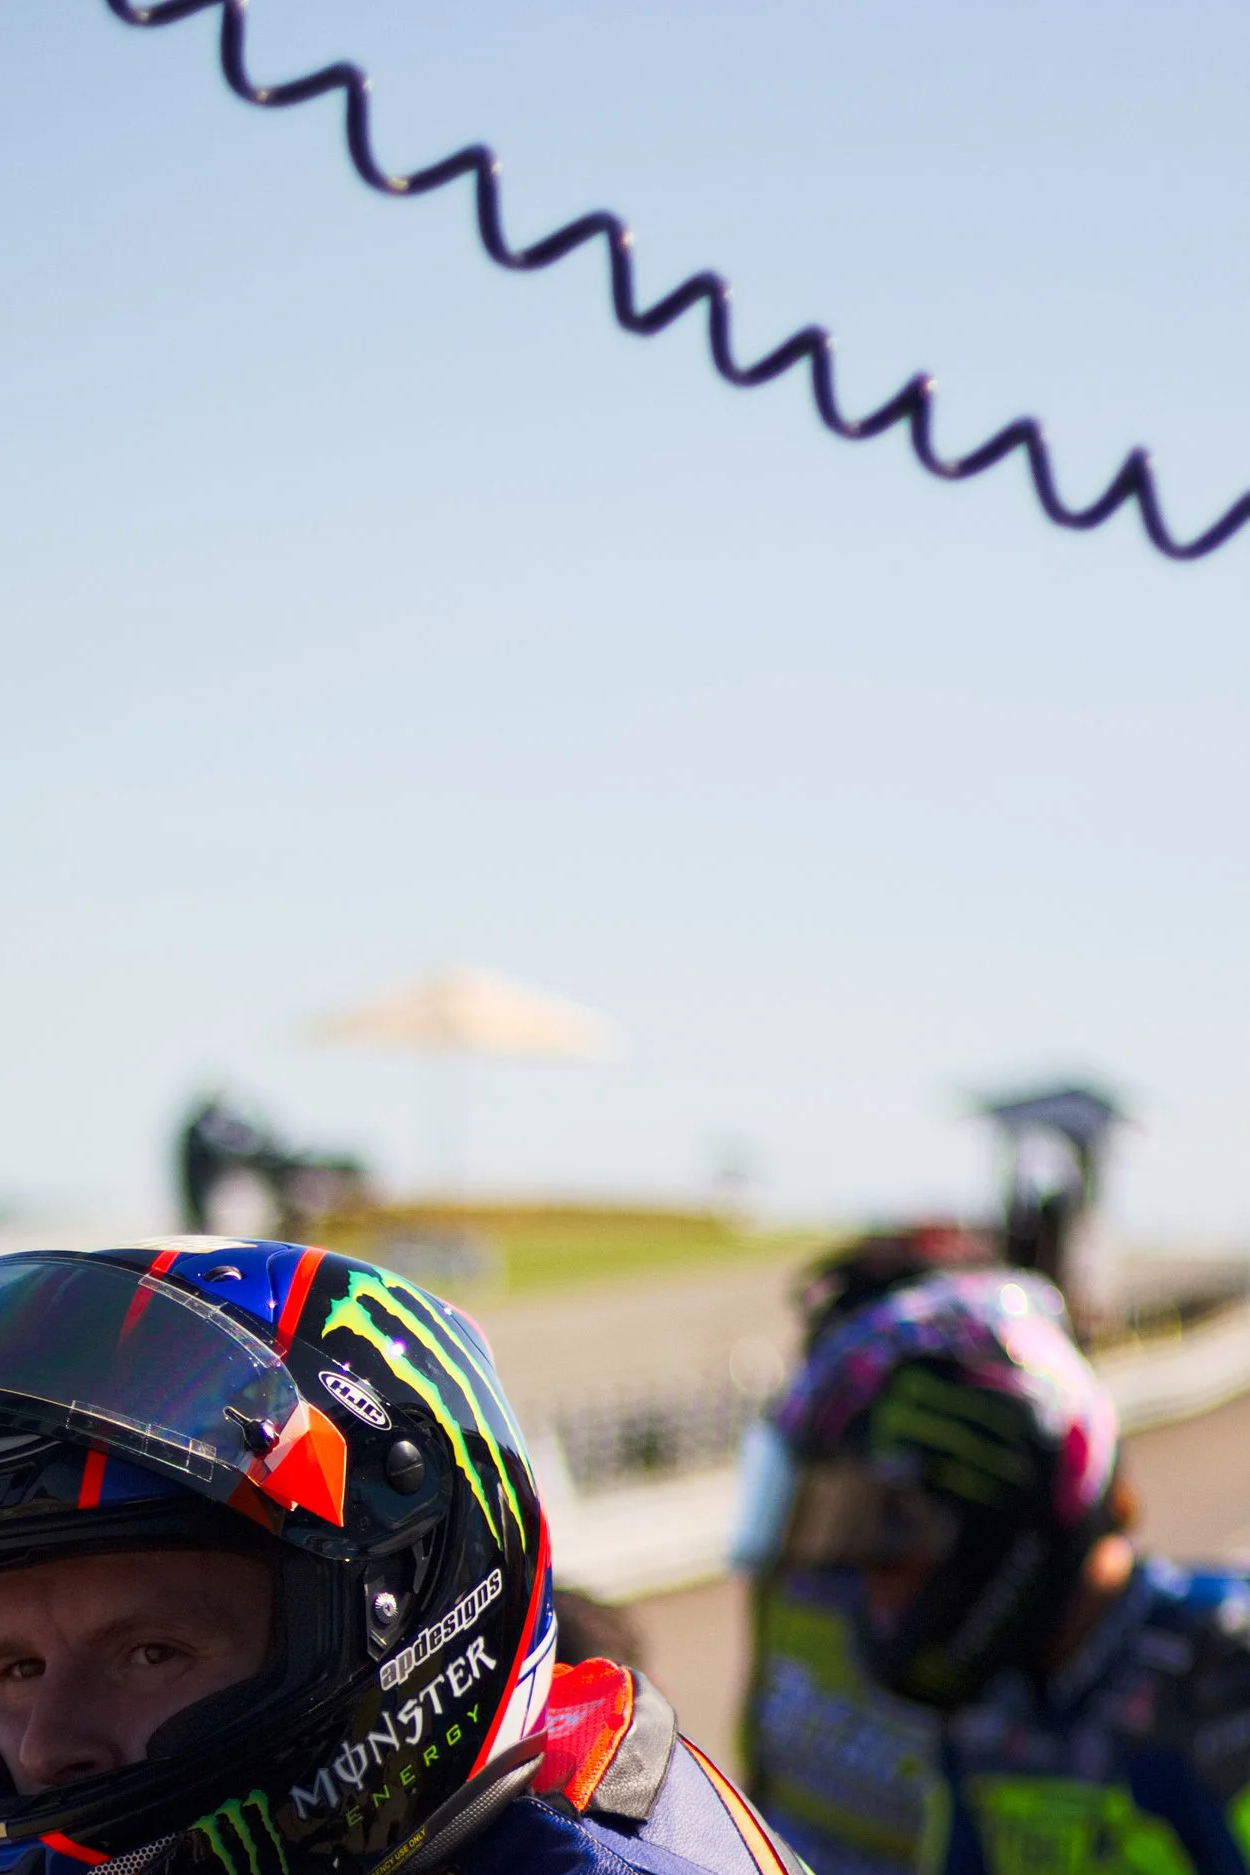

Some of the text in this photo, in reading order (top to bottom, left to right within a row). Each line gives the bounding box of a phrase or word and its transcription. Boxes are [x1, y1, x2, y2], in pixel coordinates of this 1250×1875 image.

[330, 1379, 383, 1422] HJC
[379, 1567, 503, 1692] apdesigns
[288, 1635, 497, 1821] MONSTER
[344, 1703, 479, 1828] ENERGY
